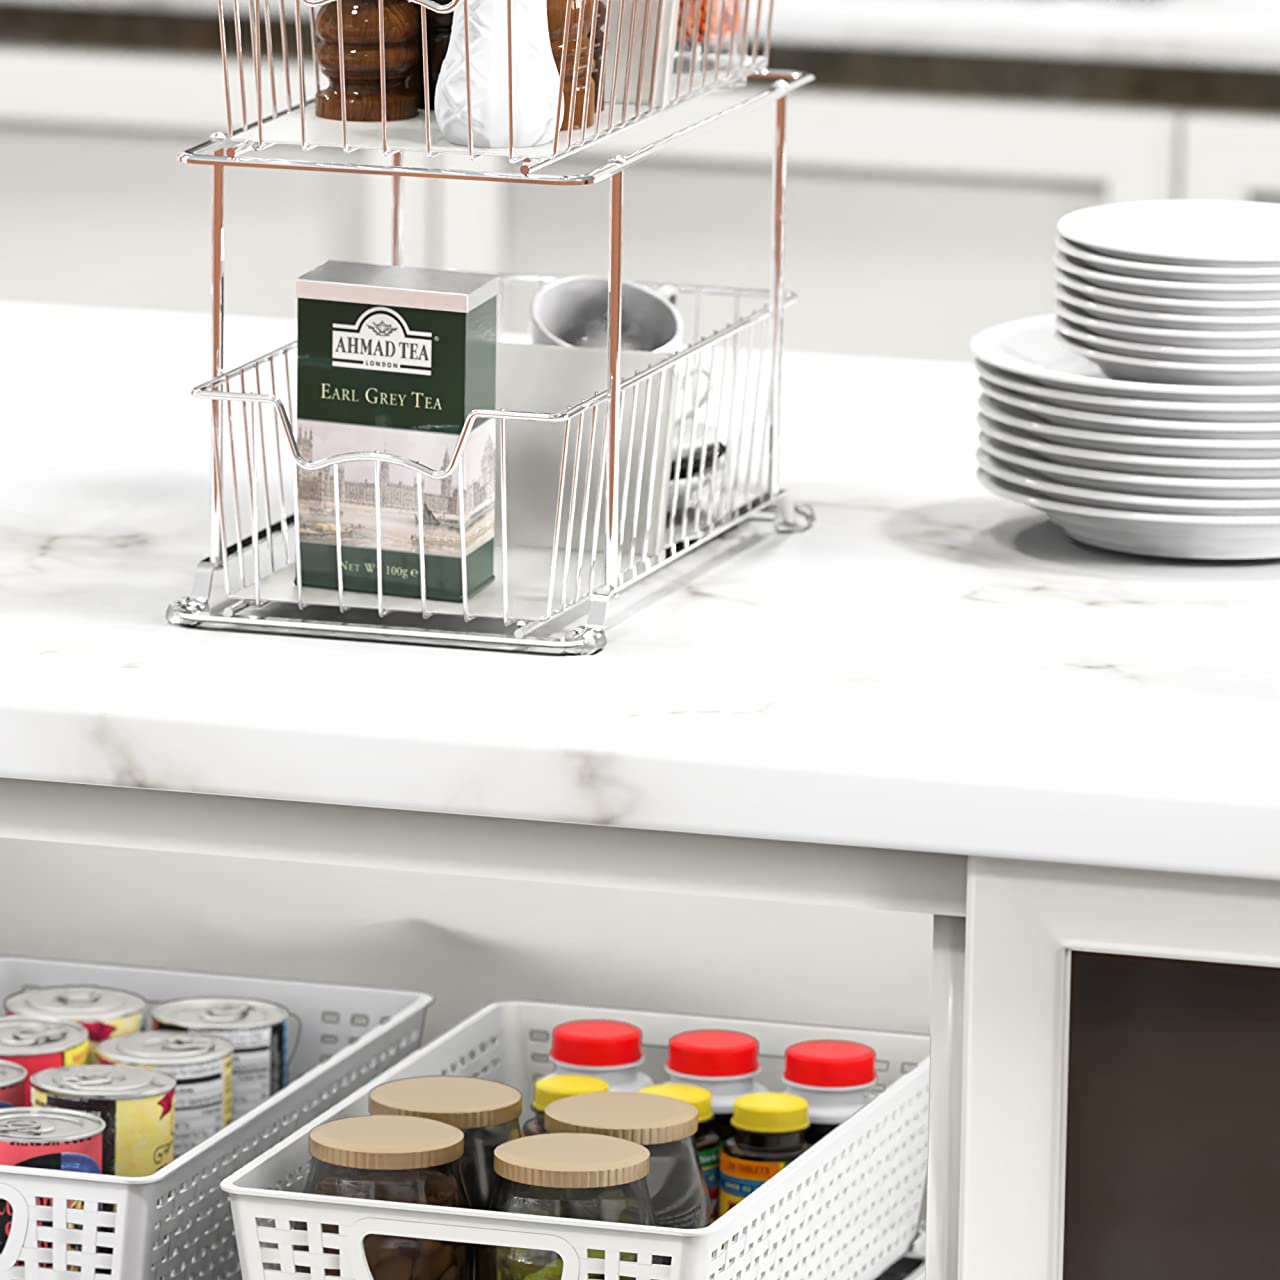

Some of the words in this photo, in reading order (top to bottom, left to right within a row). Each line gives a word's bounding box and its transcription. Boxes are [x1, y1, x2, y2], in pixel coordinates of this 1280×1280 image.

[334, 337, 395, 358] AHMAD
[398, 342, 430, 362] TEA
[365, 360, 398, 370] LONDON
[320, 382, 359, 403] EARL
[365, 386, 407, 408] GREY
[411, 390, 443, 411] TEA
[386, 565, 408, 579] 100g
